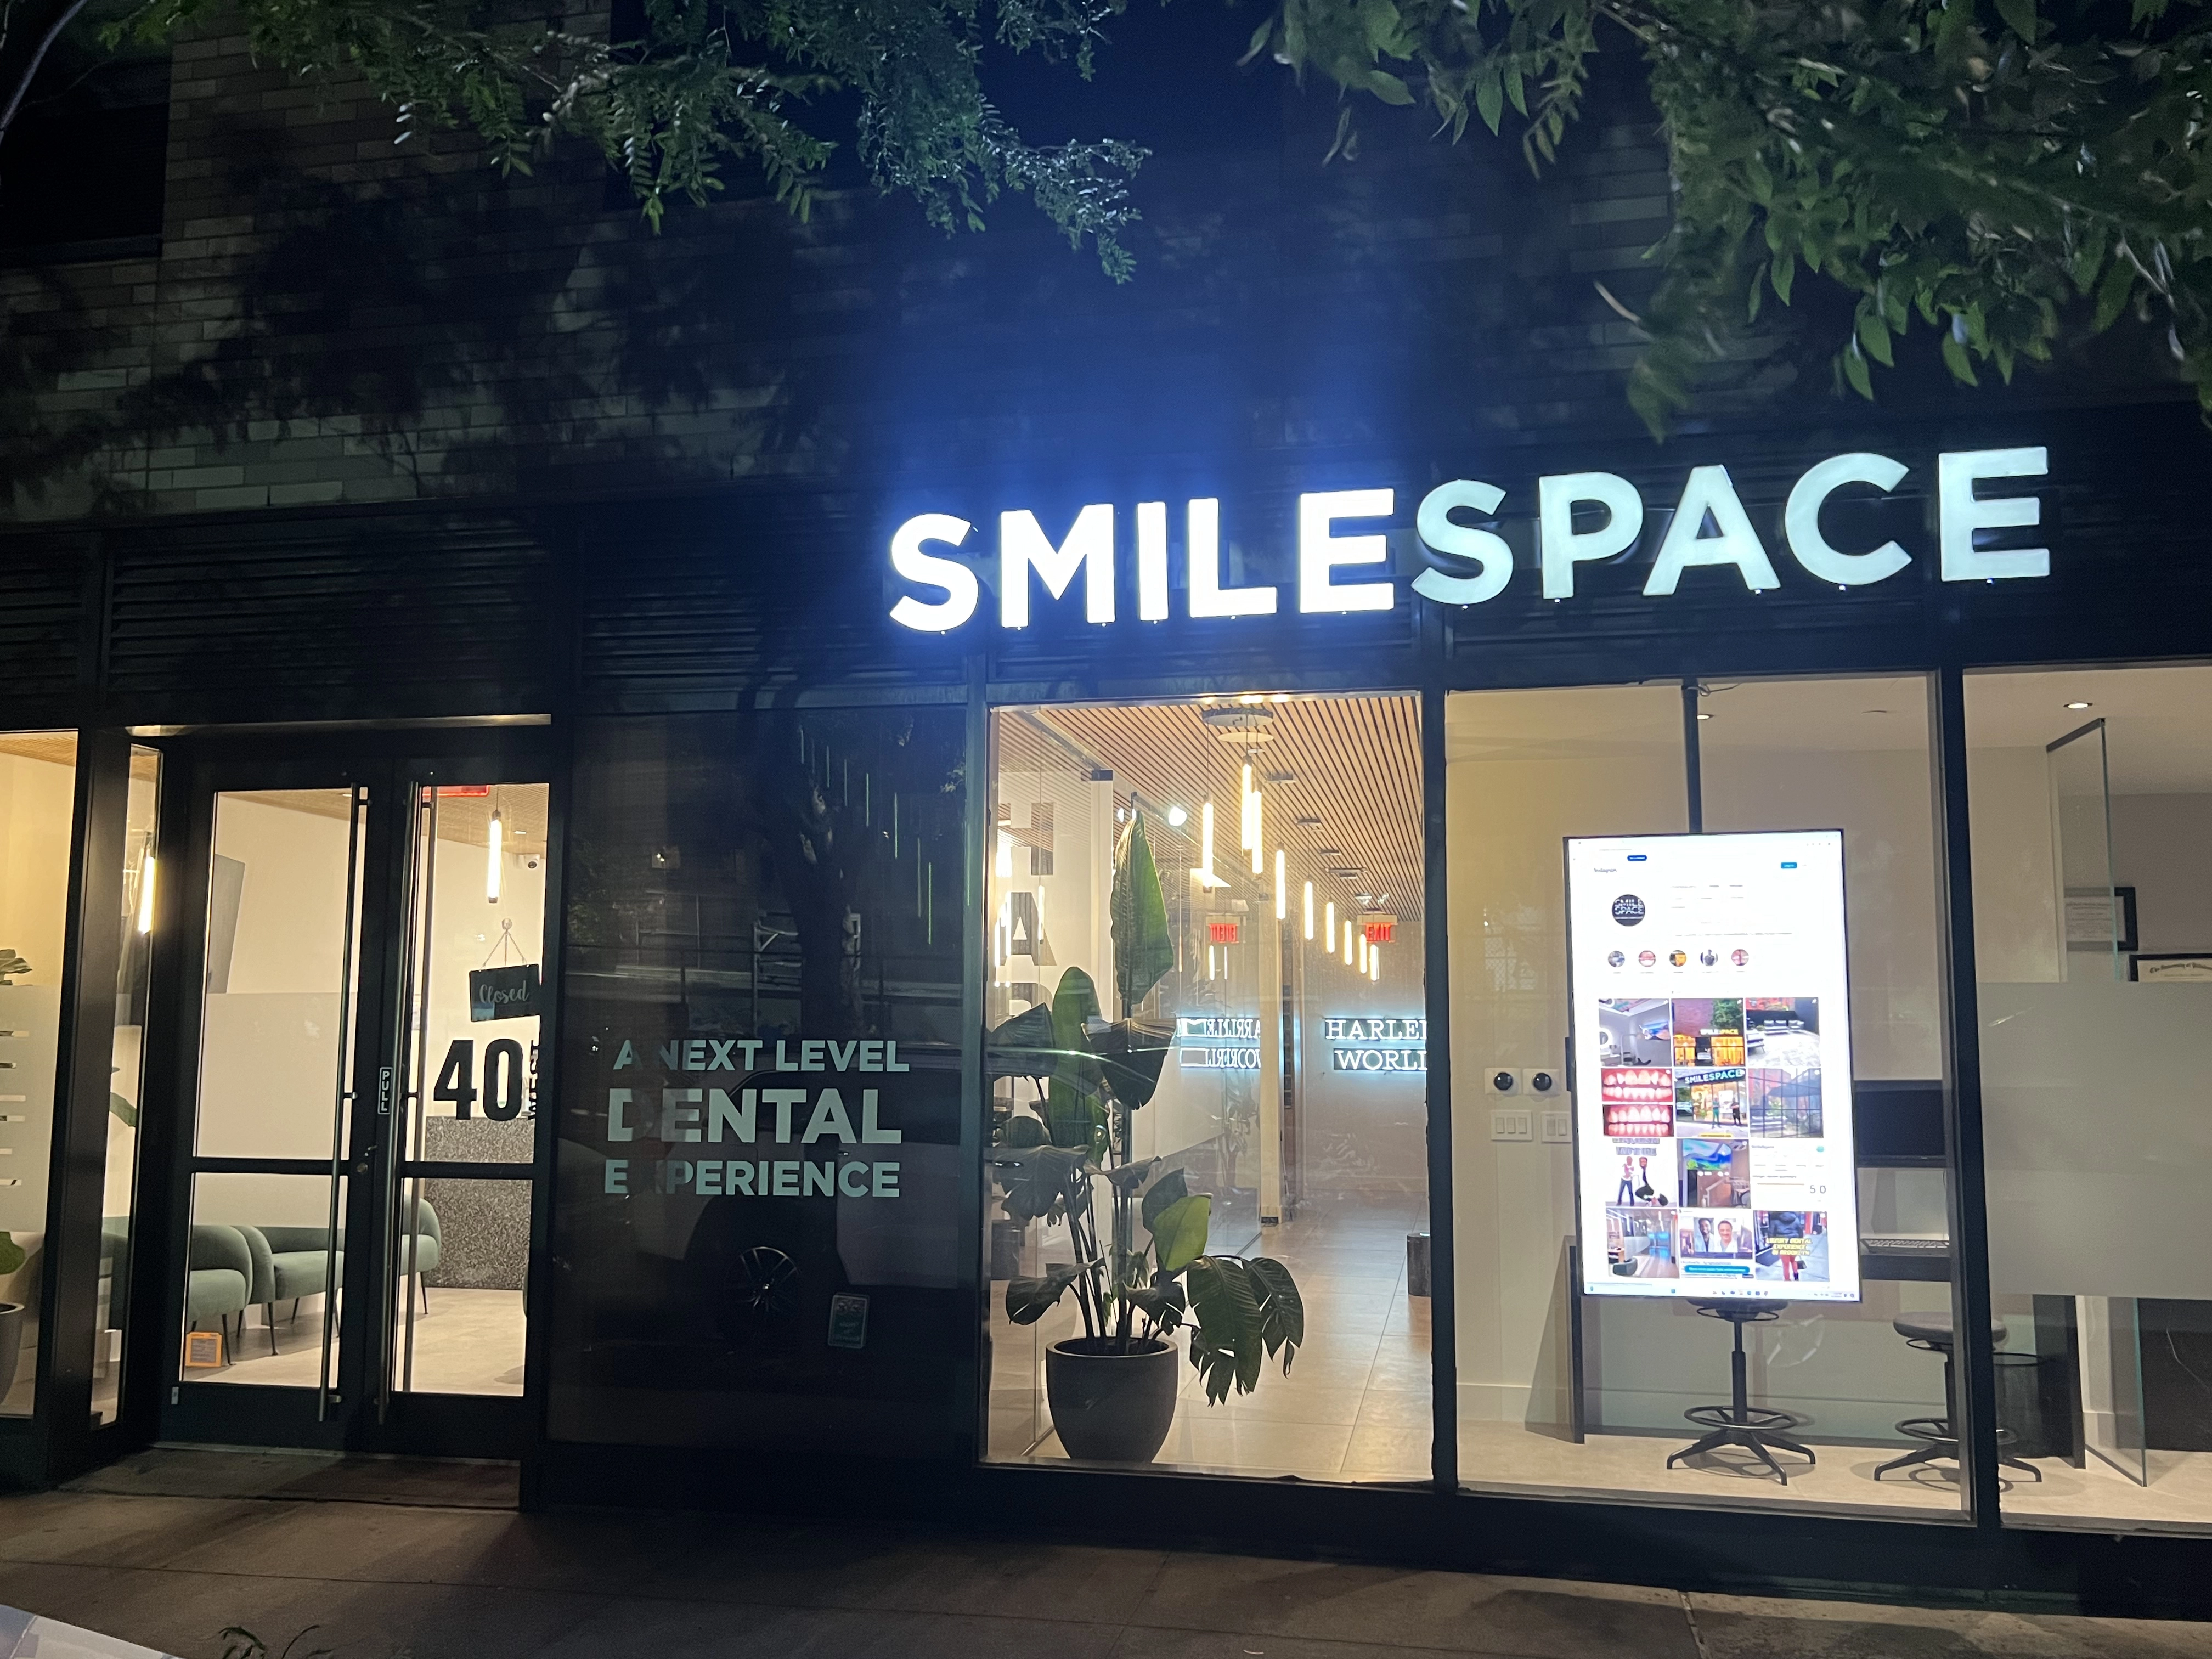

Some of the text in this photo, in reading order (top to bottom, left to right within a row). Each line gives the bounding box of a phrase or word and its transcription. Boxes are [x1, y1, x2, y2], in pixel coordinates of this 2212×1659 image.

[1366, 923, 1390, 941] EXIT
[479, 980, 529, 1004] Closed
[613, 1039, 910, 1072] A NEXT LEVEL
[381, 1071, 390, 1111] PULL
[433, 1039, 522, 1121] 40
[607, 1088, 902, 1144] DENTAL
[605, 1159, 900, 1198] EPERIENCE
